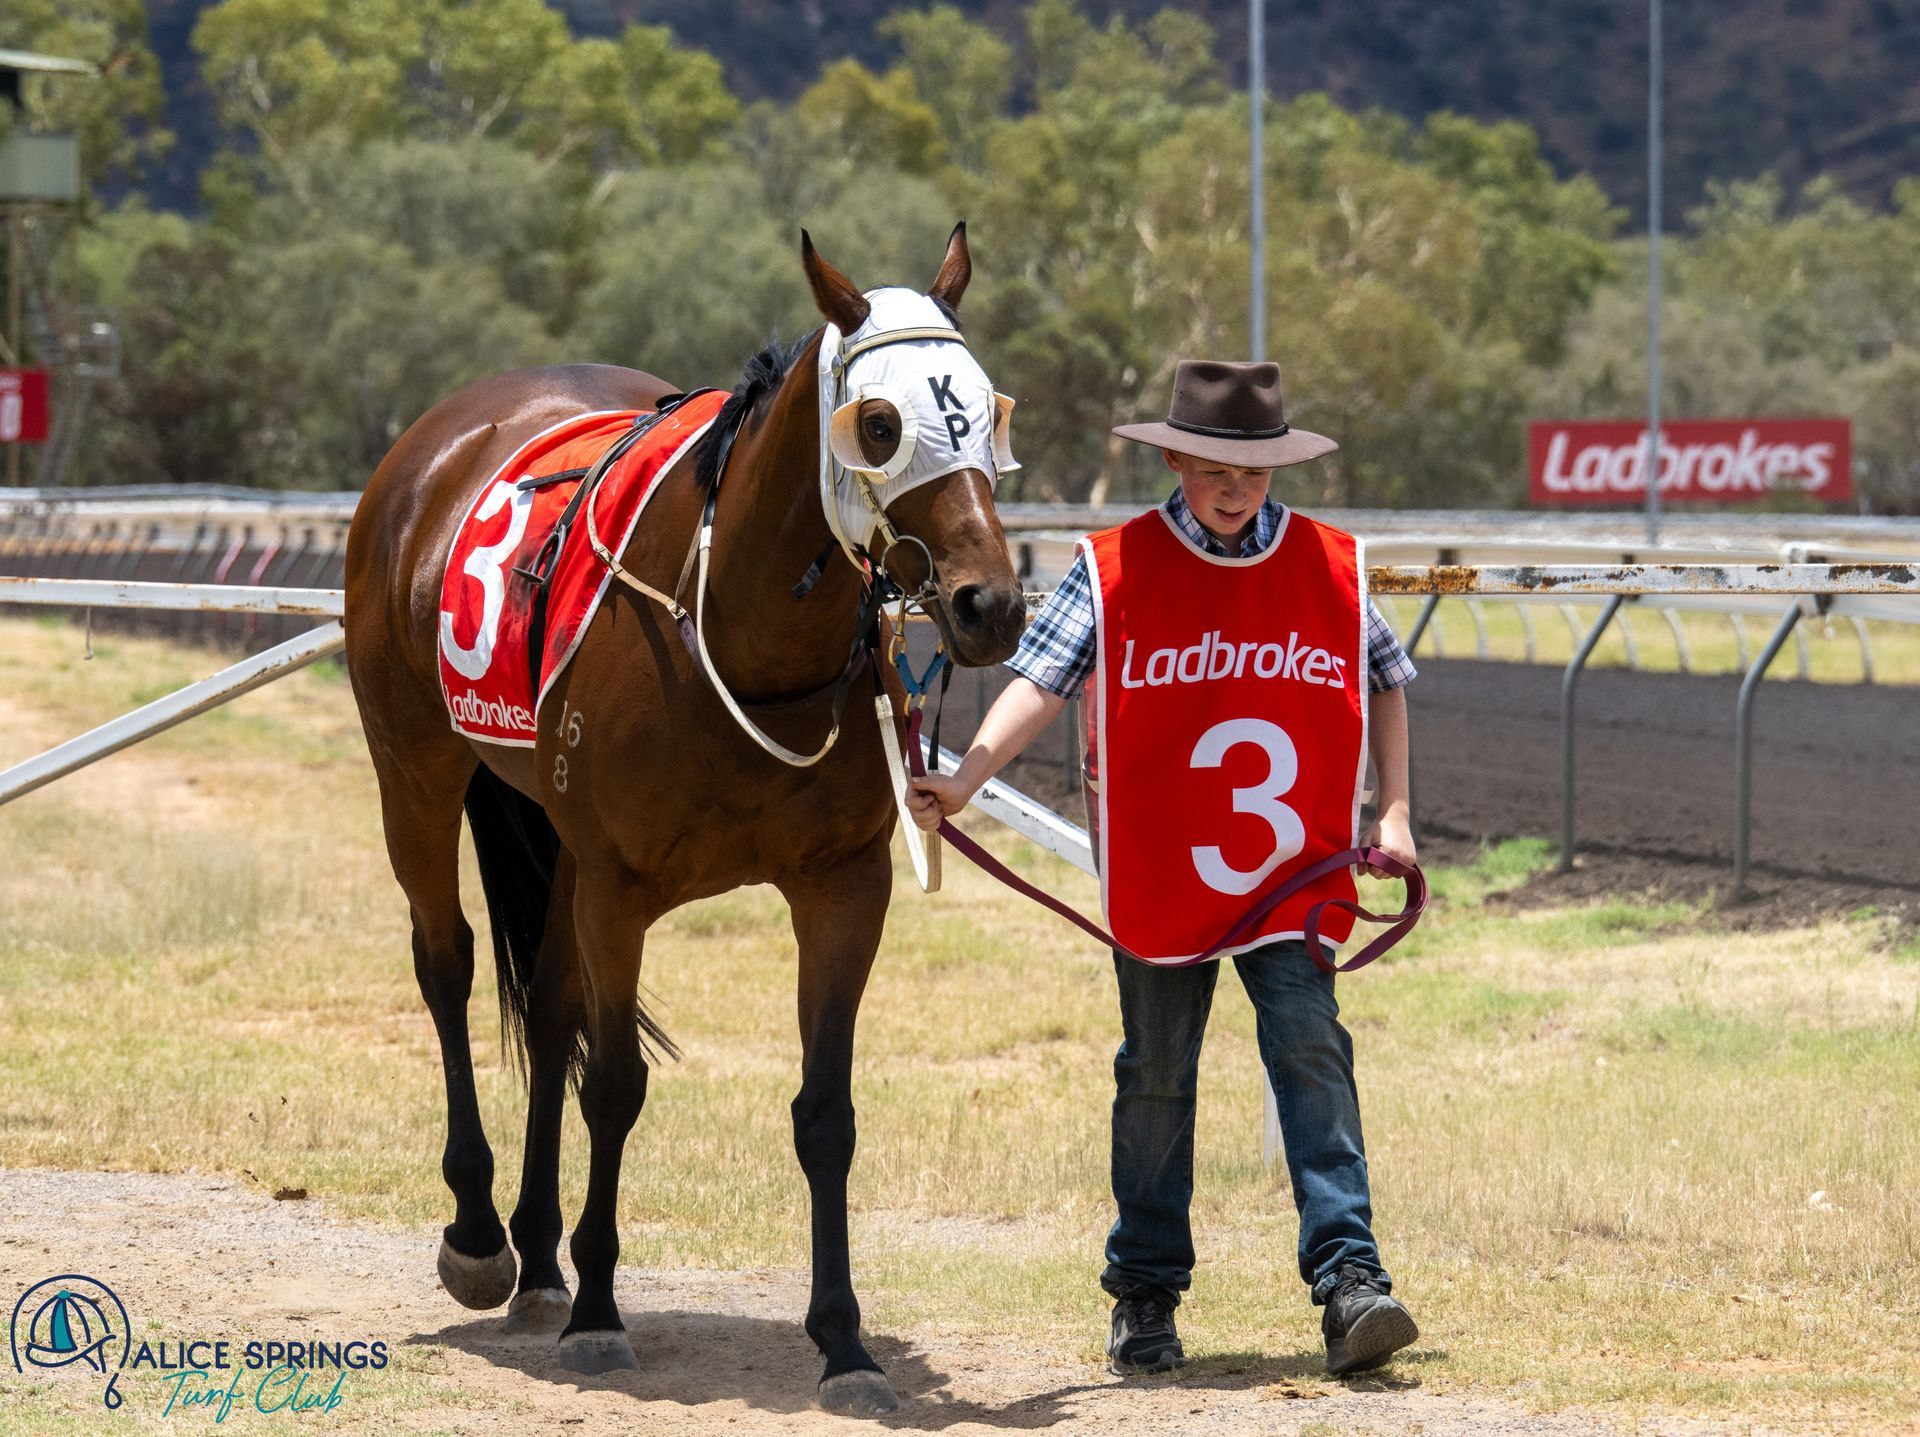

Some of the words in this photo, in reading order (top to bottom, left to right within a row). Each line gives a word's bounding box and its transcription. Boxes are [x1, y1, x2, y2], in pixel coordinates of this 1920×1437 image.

[927, 374, 966, 412] K
[944, 412, 971, 452] P
[440, 474, 536, 681] 3
[1121, 630, 1346, 689] Ladbrokes
[1189, 718, 1305, 895] 3
